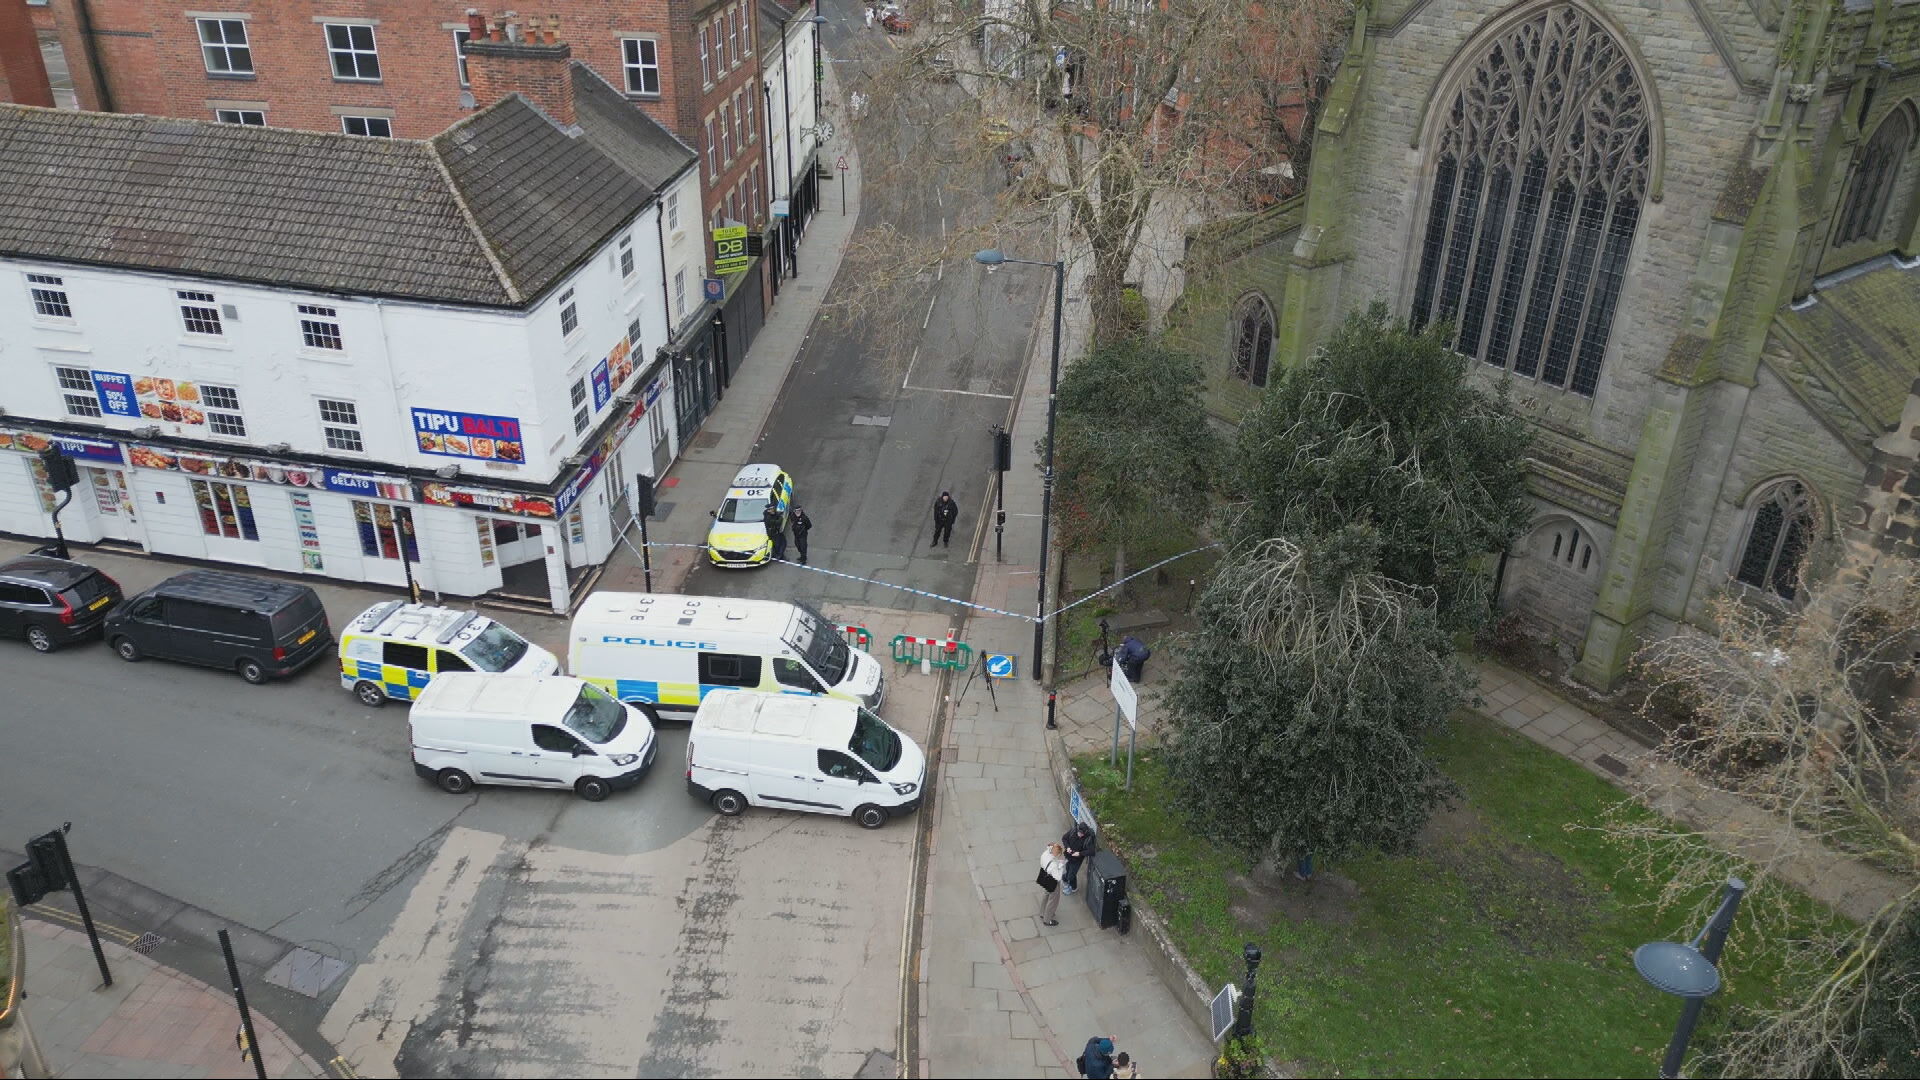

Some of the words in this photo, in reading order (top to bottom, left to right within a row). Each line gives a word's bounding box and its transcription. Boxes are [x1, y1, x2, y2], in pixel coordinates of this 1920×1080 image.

[94, 373, 126, 385] BUFFET
[107, 399, 129, 411] OFF
[413, 411, 459, 432] TIPU
[462, 415, 520, 440] BALTI
[330, 475, 370, 489] GELATO
[747, 489, 764, 497] 30
[602, 636, 718, 651] POLICE
